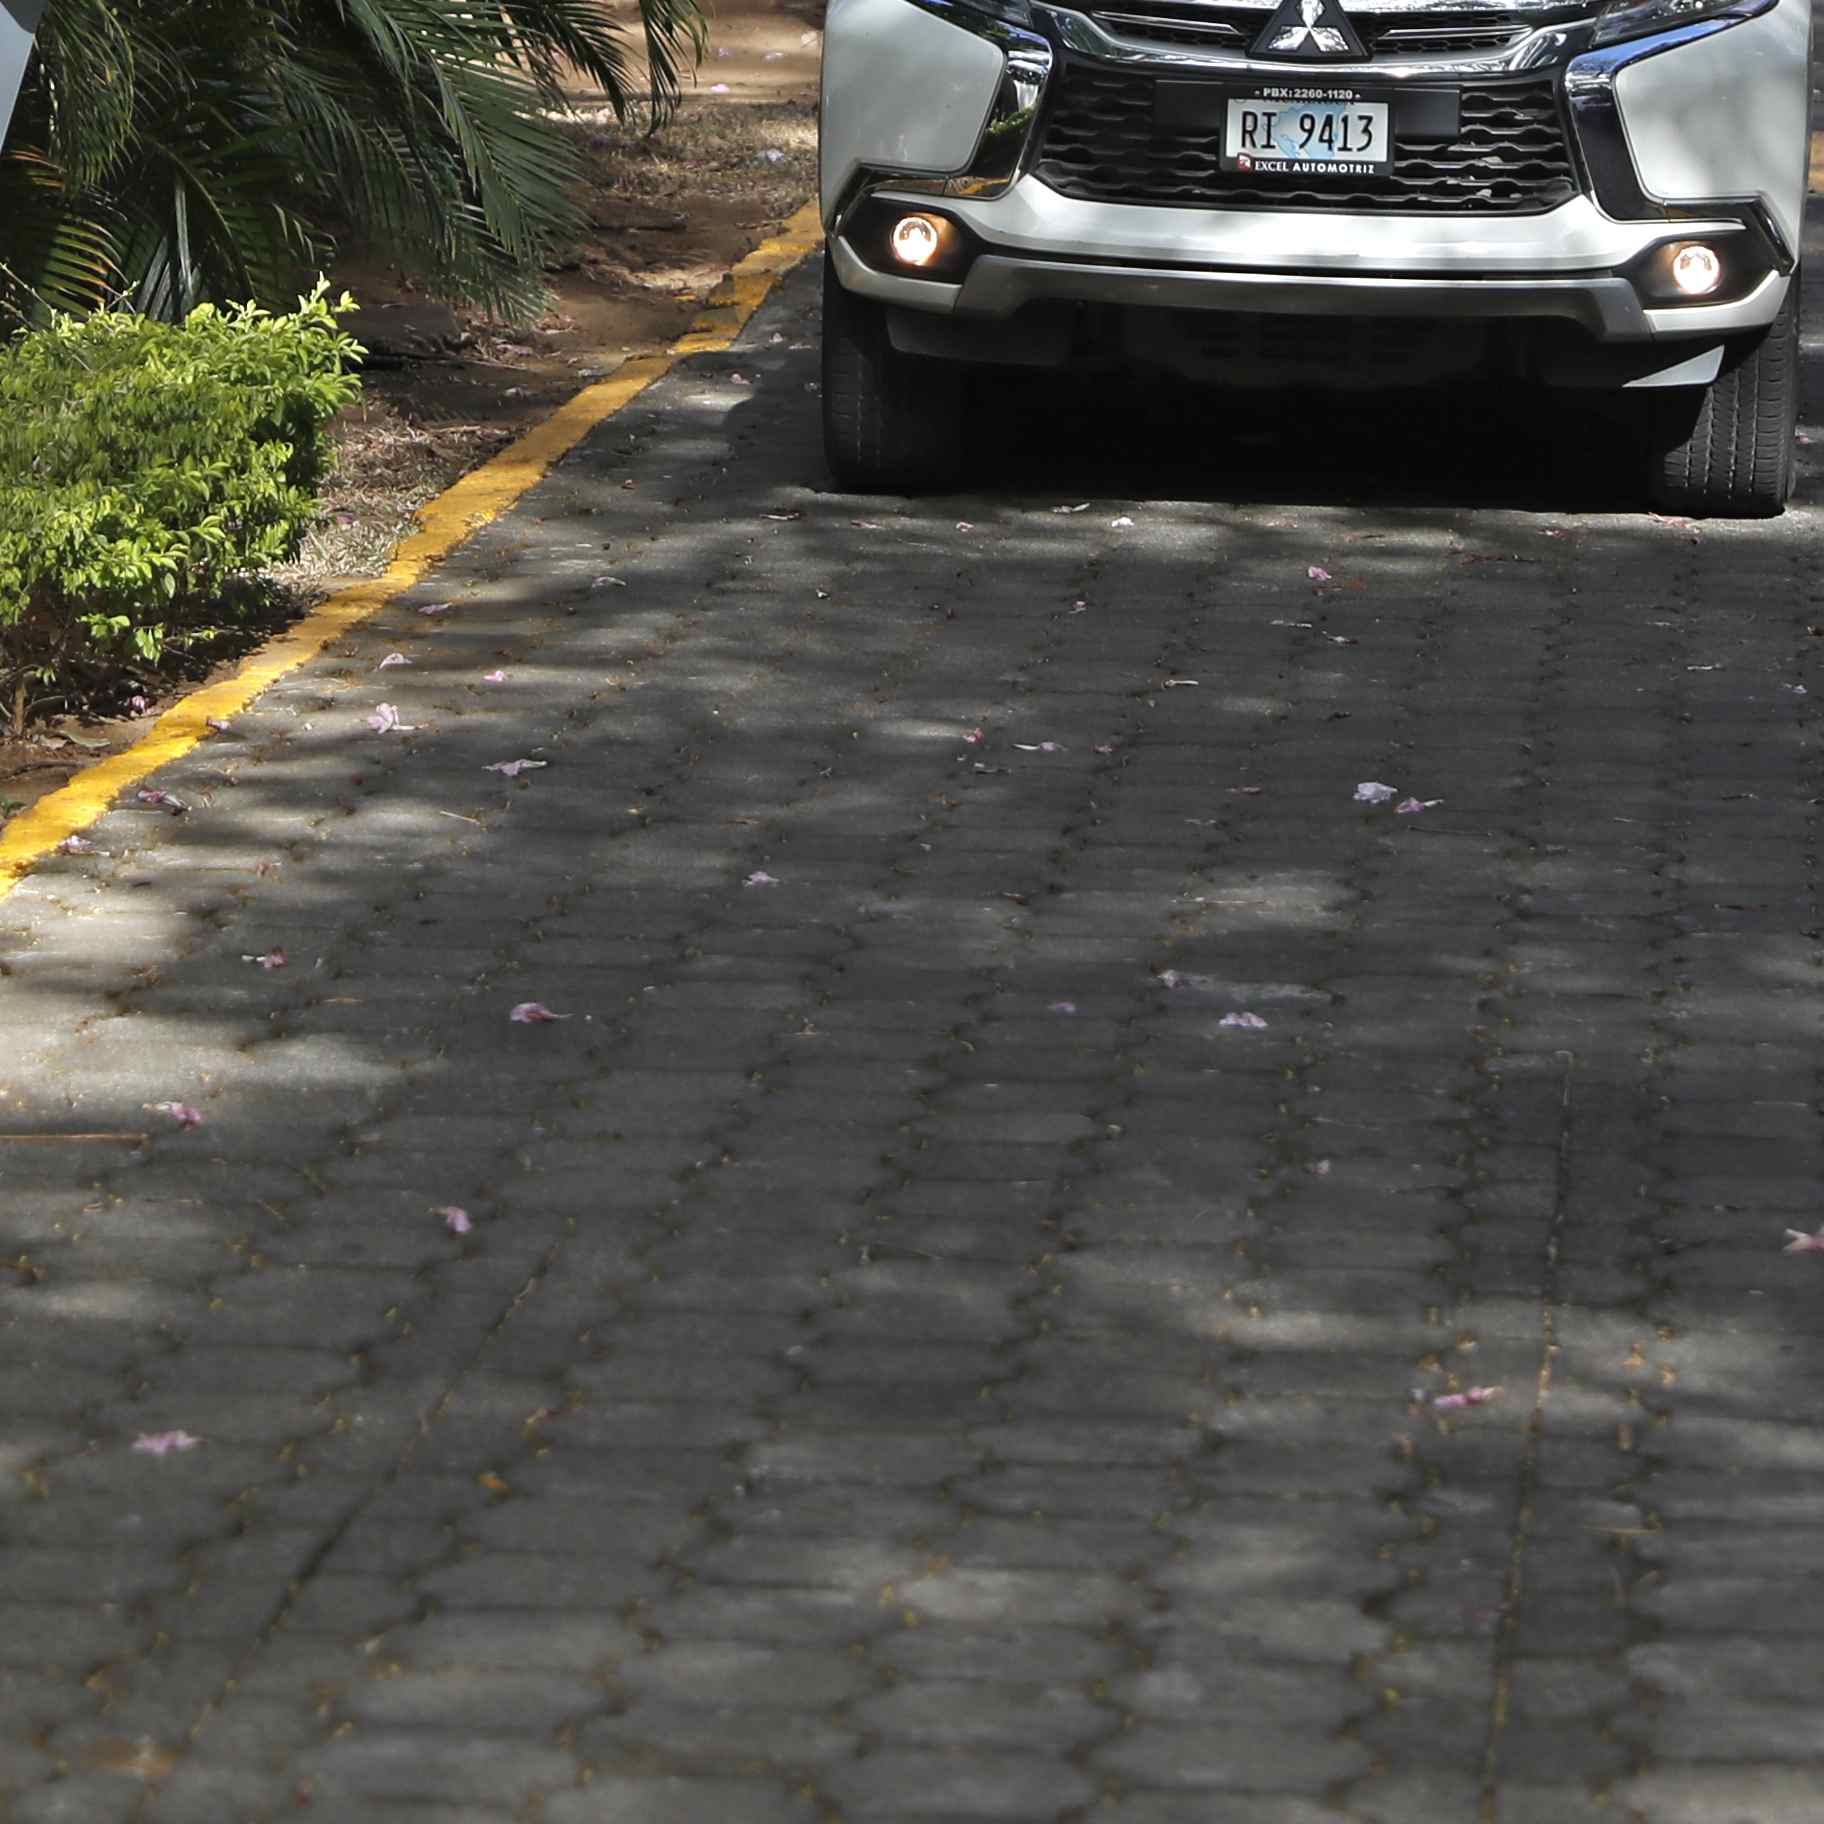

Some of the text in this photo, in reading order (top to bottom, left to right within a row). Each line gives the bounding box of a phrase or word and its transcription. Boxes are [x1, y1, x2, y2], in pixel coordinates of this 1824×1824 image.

[1241, 110, 1374, 152] RI 9413
[1254, 160, 1376, 175] EXCEL AUTOMOTRIZ
